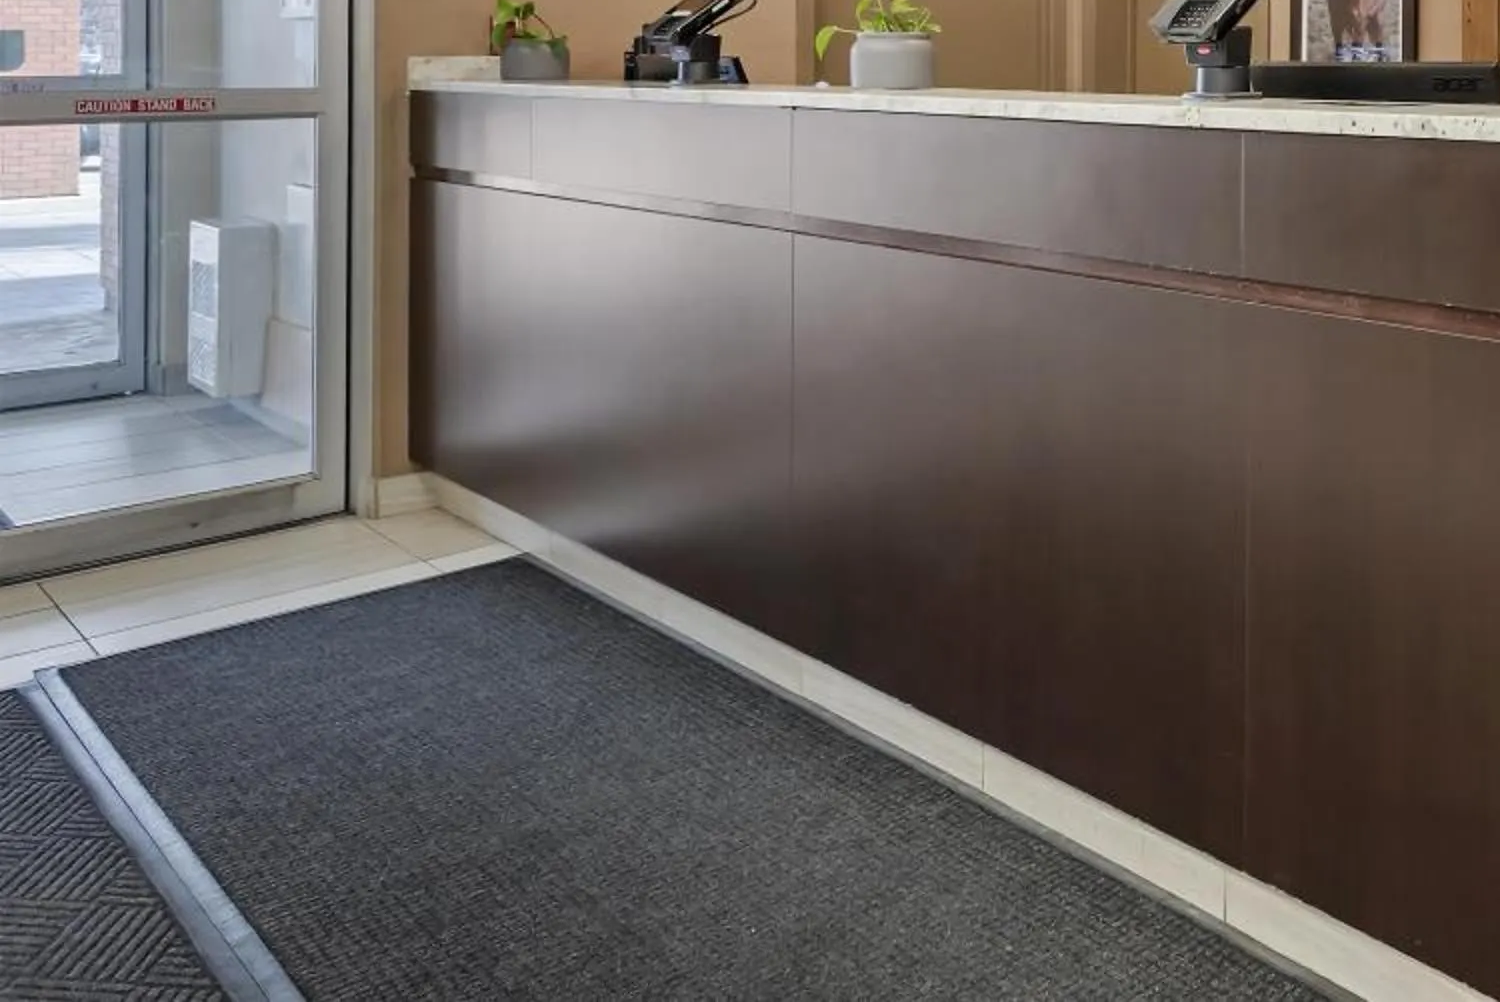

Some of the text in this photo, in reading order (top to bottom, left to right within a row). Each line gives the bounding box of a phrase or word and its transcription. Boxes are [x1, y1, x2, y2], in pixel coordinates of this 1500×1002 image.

[77, 99, 214, 113] CAUTION STAND BACK
